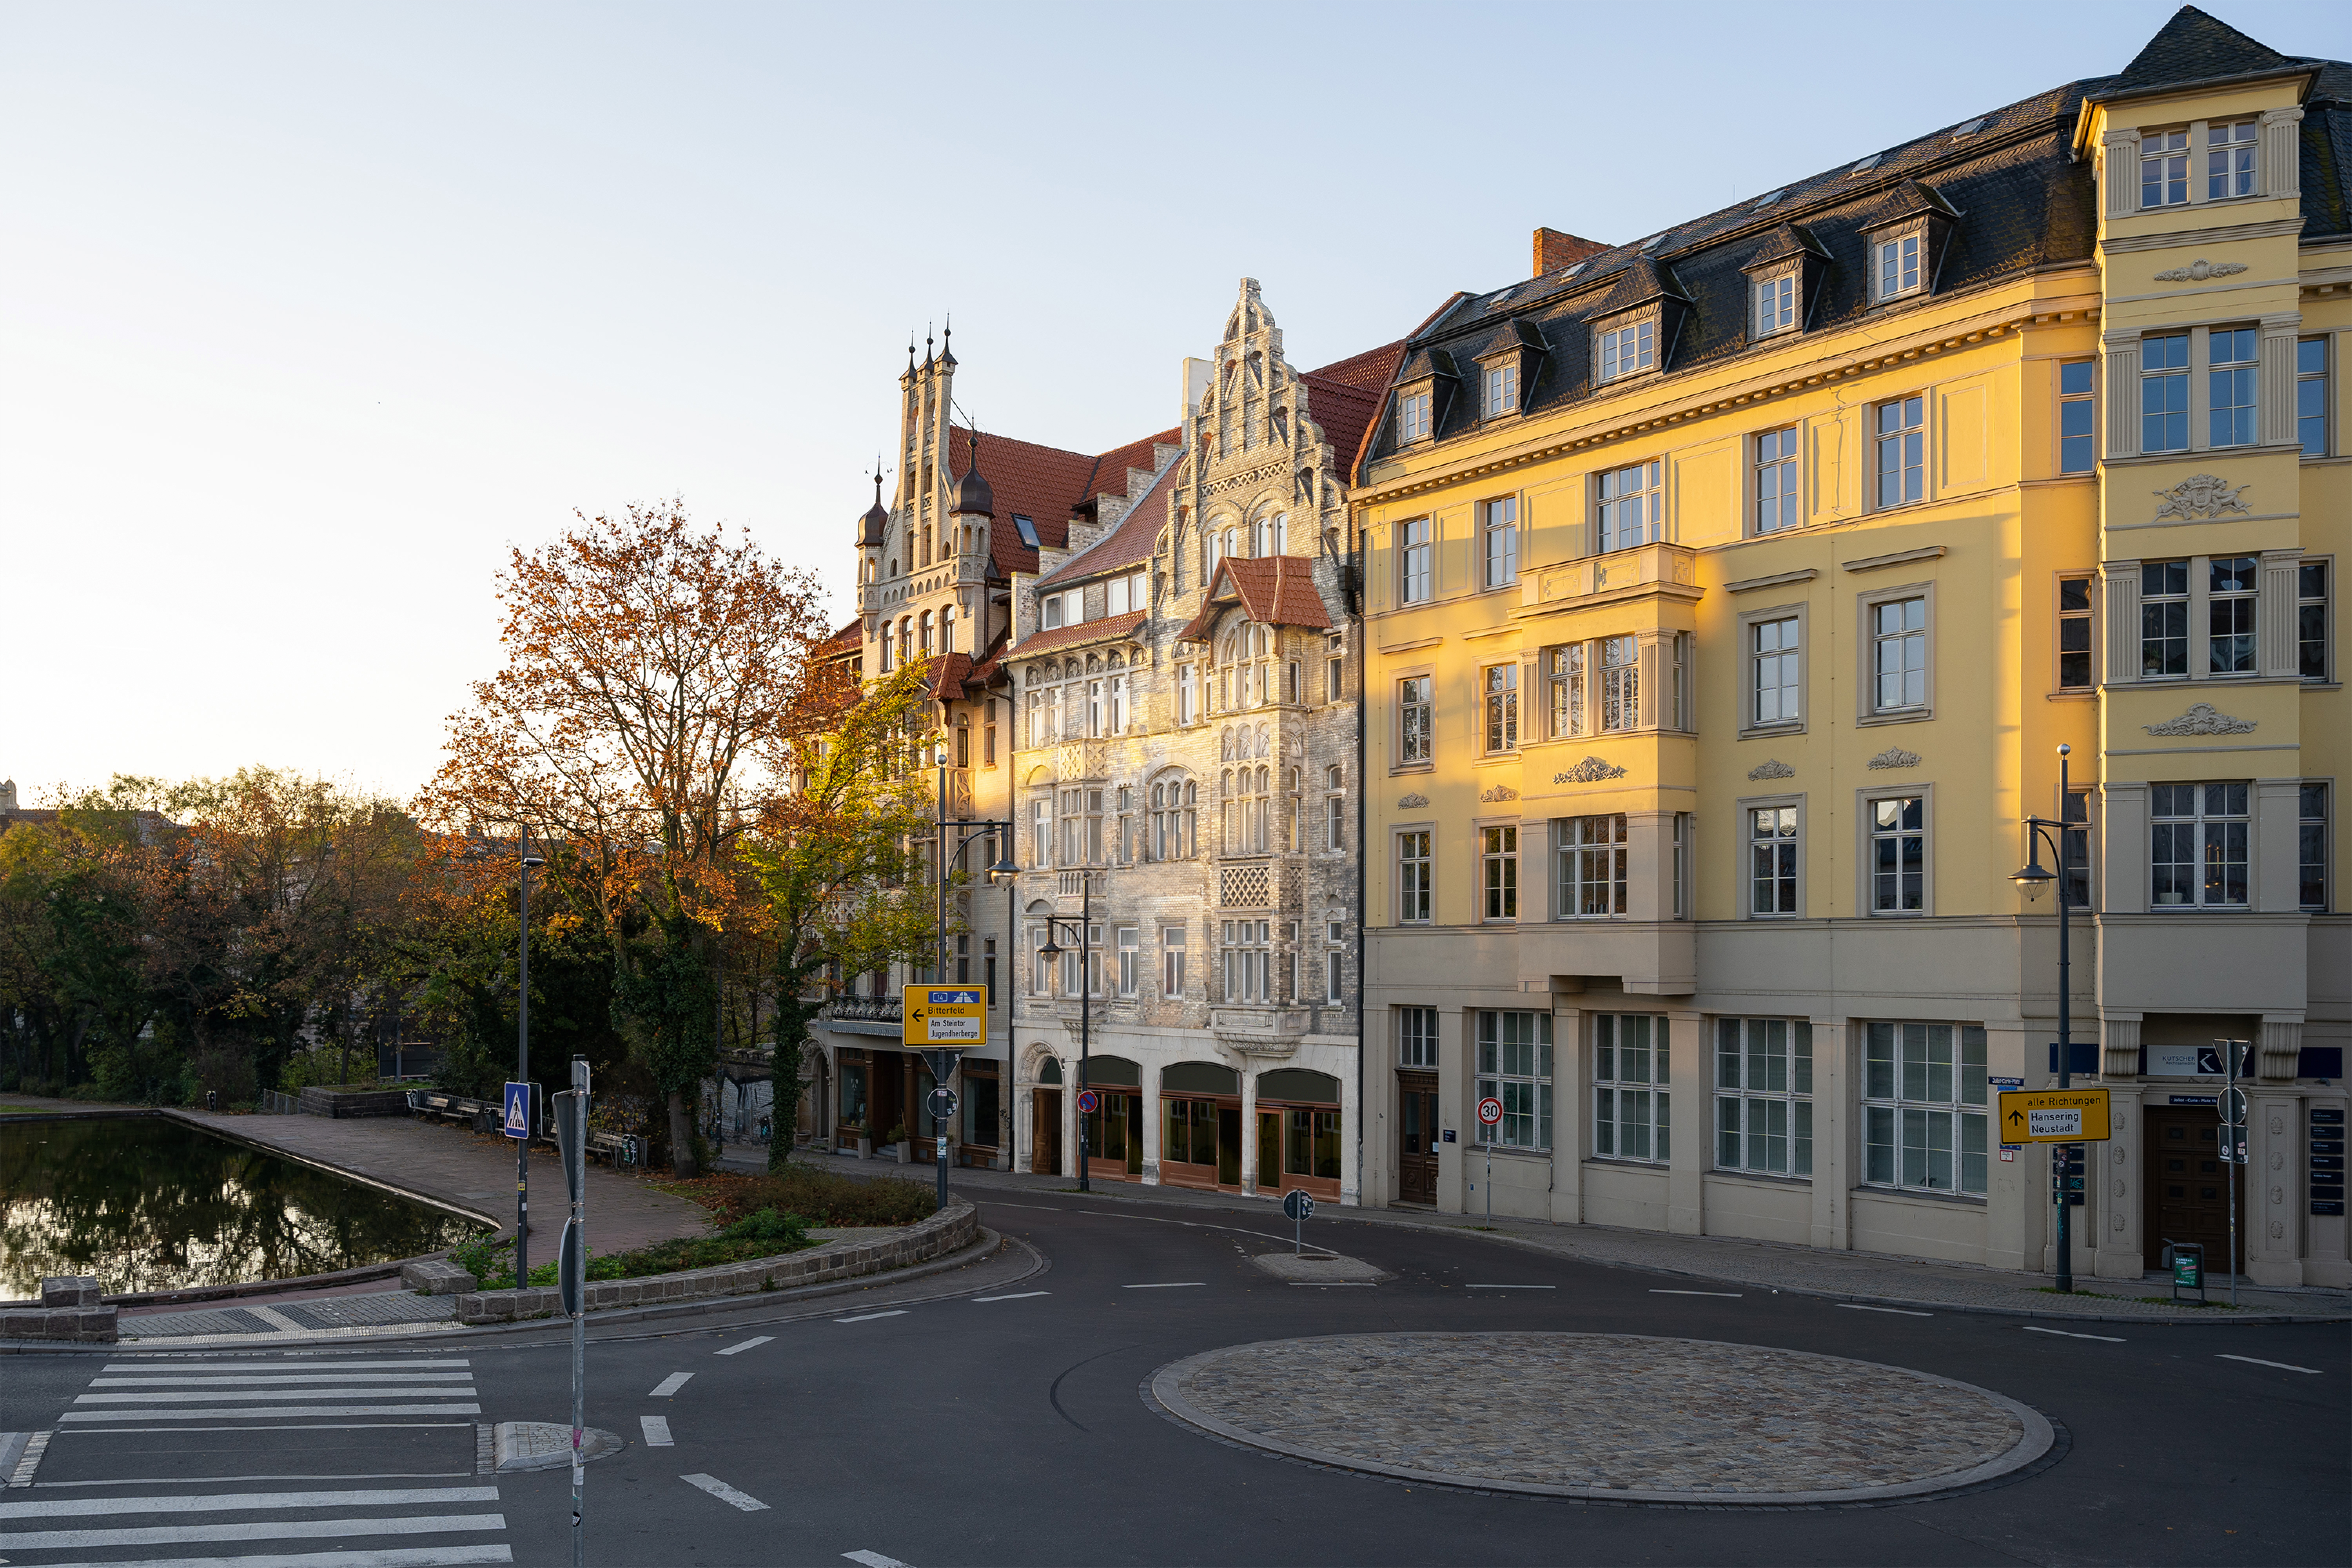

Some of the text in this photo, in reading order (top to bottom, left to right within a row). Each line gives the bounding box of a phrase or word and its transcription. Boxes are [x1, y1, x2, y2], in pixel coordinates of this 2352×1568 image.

[931, 1030, 977, 1039] Jugendherberge
[2049, 1097, 2101, 1107] Richtungen
[1483, 1105, 1497, 1117] 30
[2031, 1112, 2079, 1122] Hansering
[2032, 1124, 2073, 1133] Neustadt
